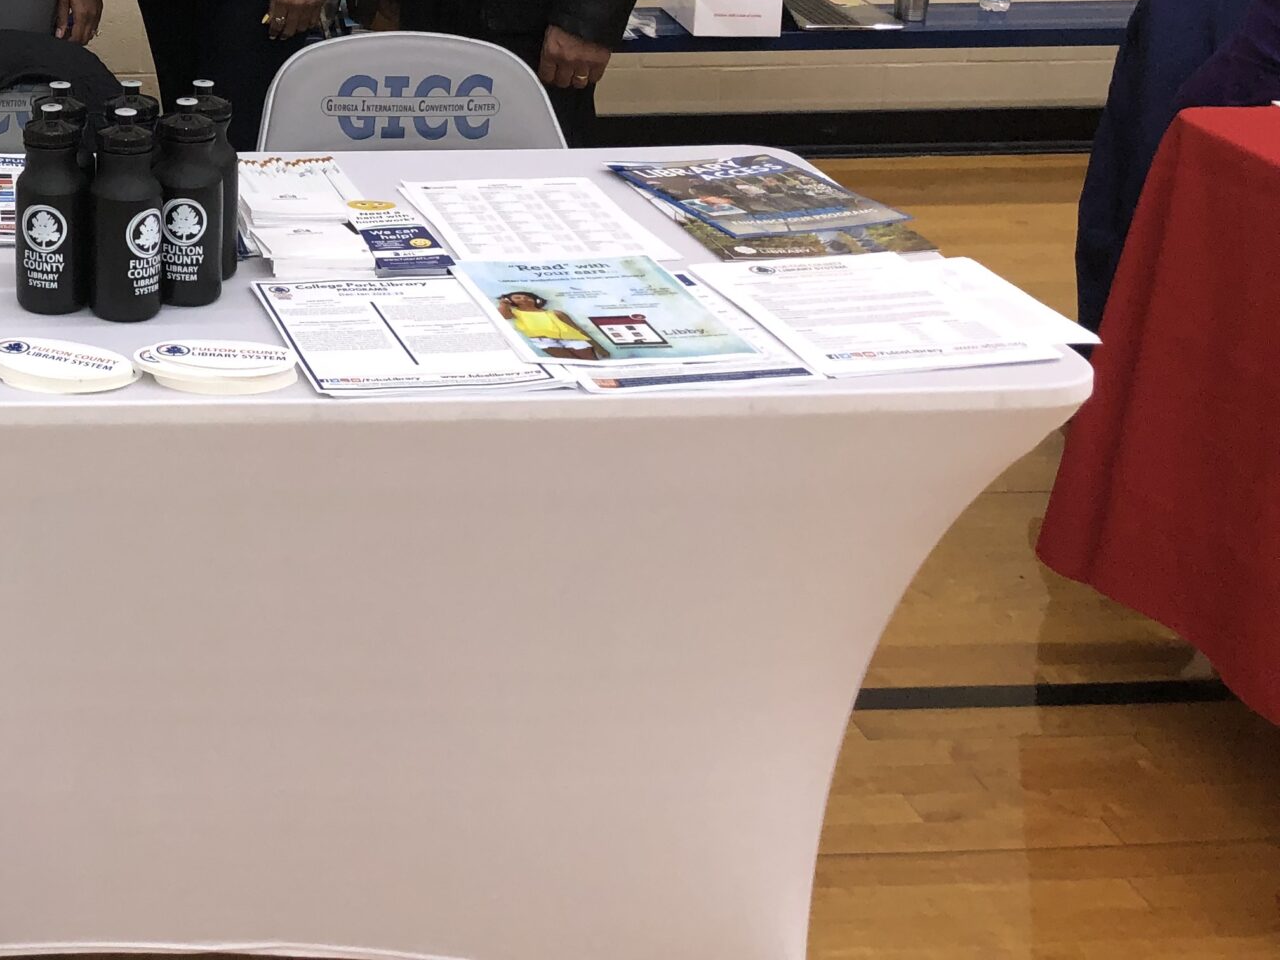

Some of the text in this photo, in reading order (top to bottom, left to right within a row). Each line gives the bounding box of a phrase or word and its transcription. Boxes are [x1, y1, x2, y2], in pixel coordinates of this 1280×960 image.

[338, 74, 493, 140] GICC
[633, 158, 741, 178] LIBRARY
[700, 163, 783, 181] ACCESS
[24, 249, 63, 263] FULTON
[162, 244, 203, 255] FULTON
[23, 258, 65, 273] COUNTY
[162, 252, 204, 265] COUNTY
[27, 270, 58, 281] LIBRARY
[166, 264, 198, 273] LIBRARY
[167, 272, 198, 281] SYSTEM
[28, 279, 58, 289] SYSTEM
[26, 350, 114, 371] LIBRARY SYSTEM
[31, 345, 120, 365] FULTON COUNTY
